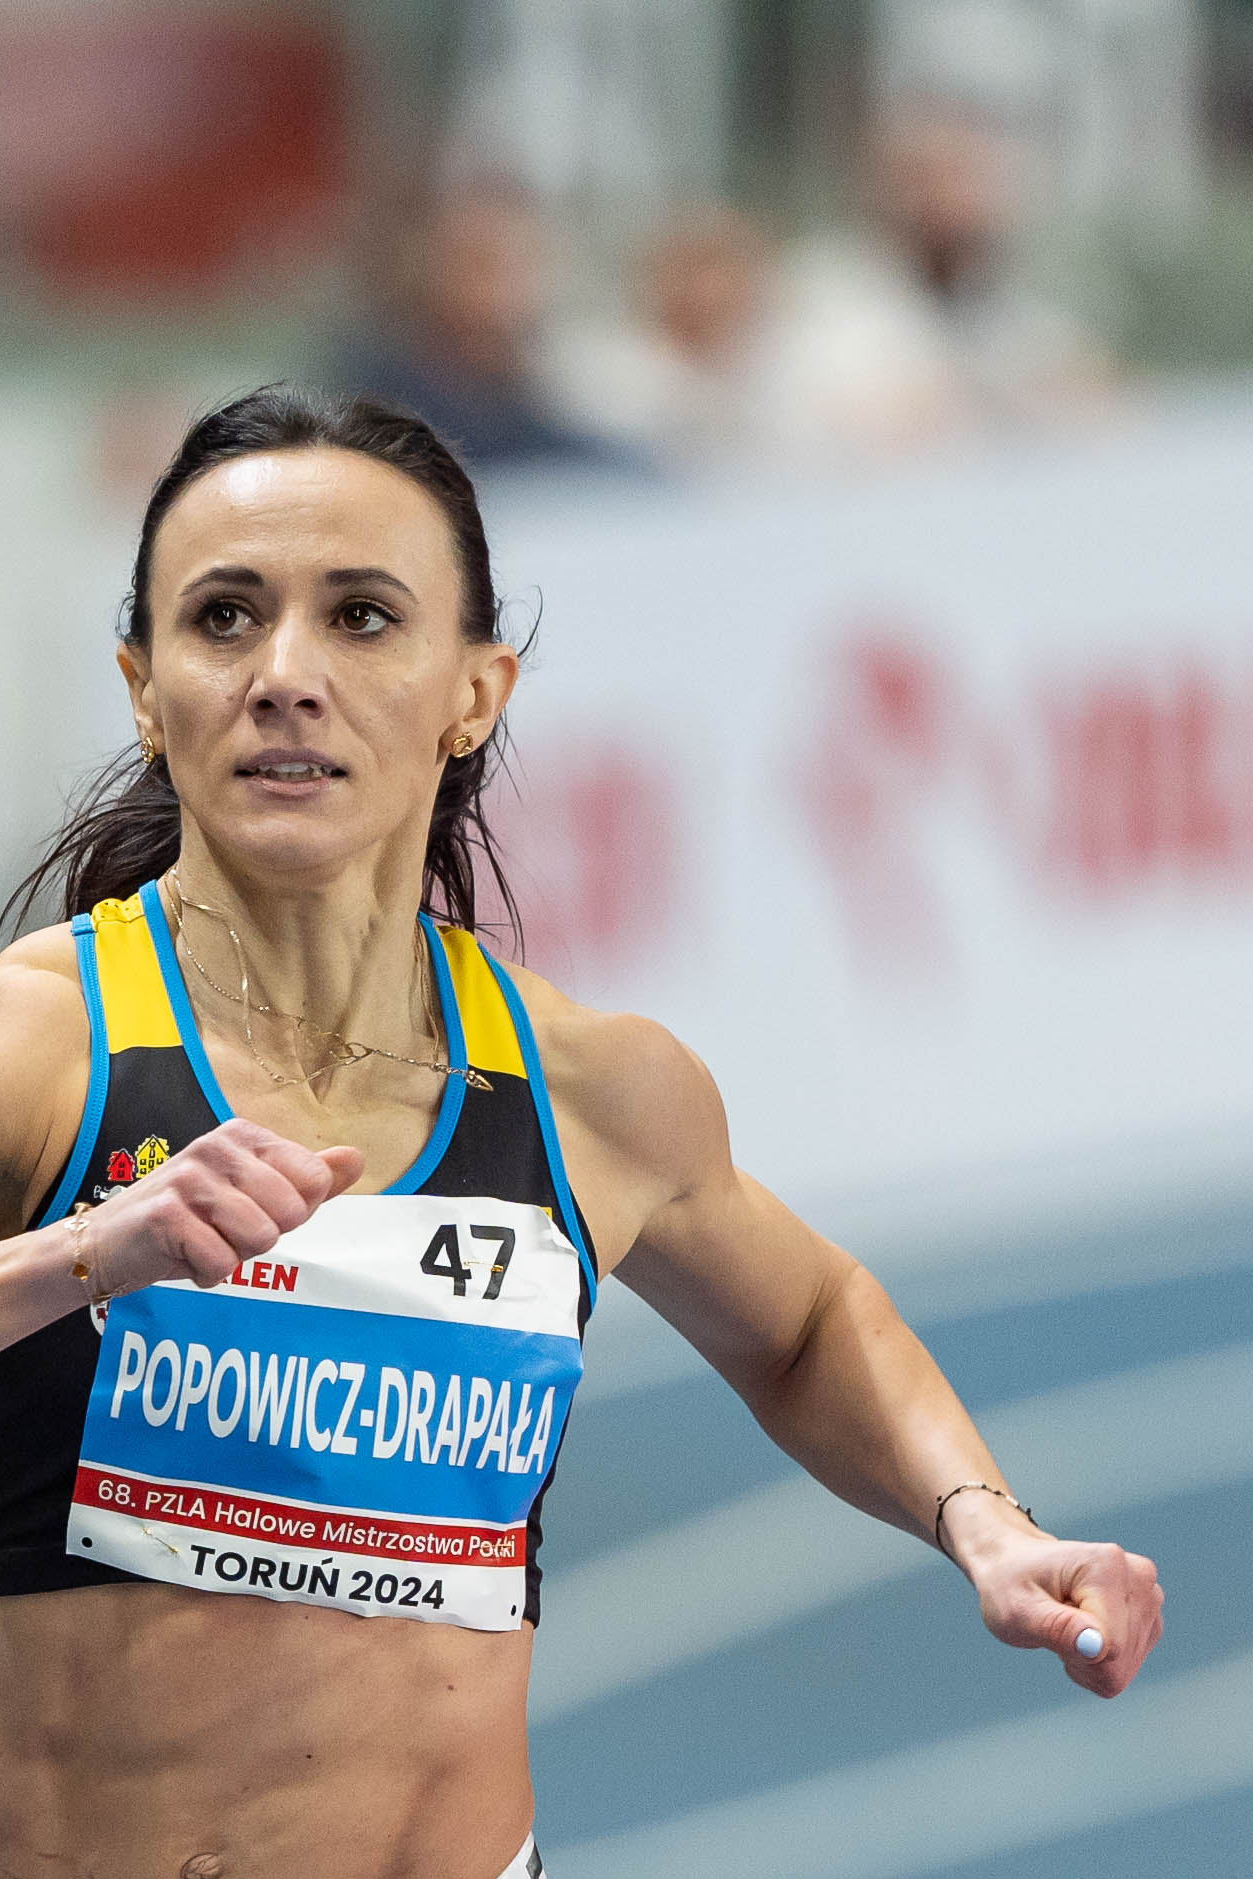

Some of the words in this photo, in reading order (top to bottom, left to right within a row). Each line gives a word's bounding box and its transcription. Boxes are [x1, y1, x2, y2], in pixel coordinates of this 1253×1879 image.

[222, 1261, 298, 1292] LEN
[419, 1224, 516, 1300] 47
[110, 1331, 556, 1474] POPOWICZ-DRAPAŁA
[98, 1479, 136, 1507] 68.
[145, 1491, 206, 1520] PZLA
[214, 1501, 316, 1539] Halowe
[322, 1520, 464, 1556] Mistrzostwa
[190, 1544, 340, 1598] TORUŃ
[348, 1570, 444, 1610] 2024
